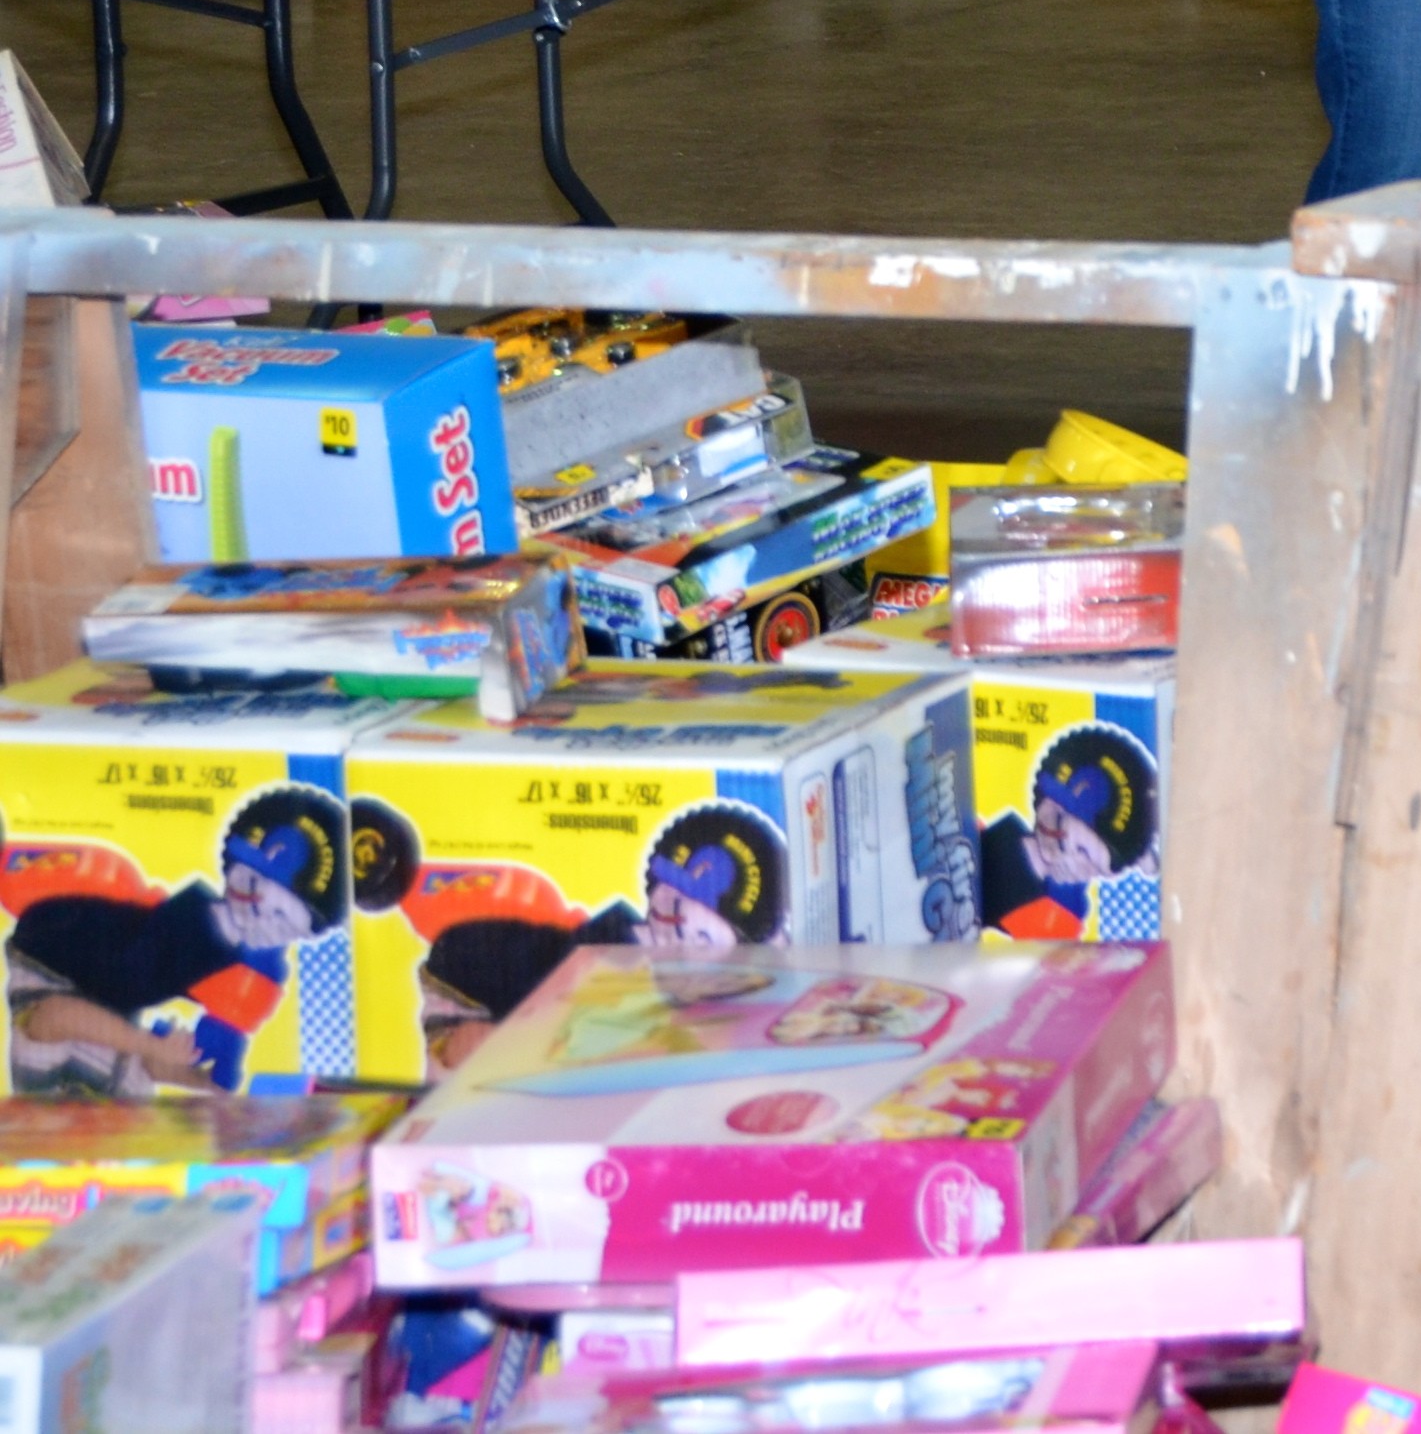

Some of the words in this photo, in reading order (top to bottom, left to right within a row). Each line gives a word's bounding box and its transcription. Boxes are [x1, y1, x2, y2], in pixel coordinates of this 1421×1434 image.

[156, 339, 340, 365] Vacuum
[161, 362, 260, 384] Set
[430, 405, 479, 516] Set
